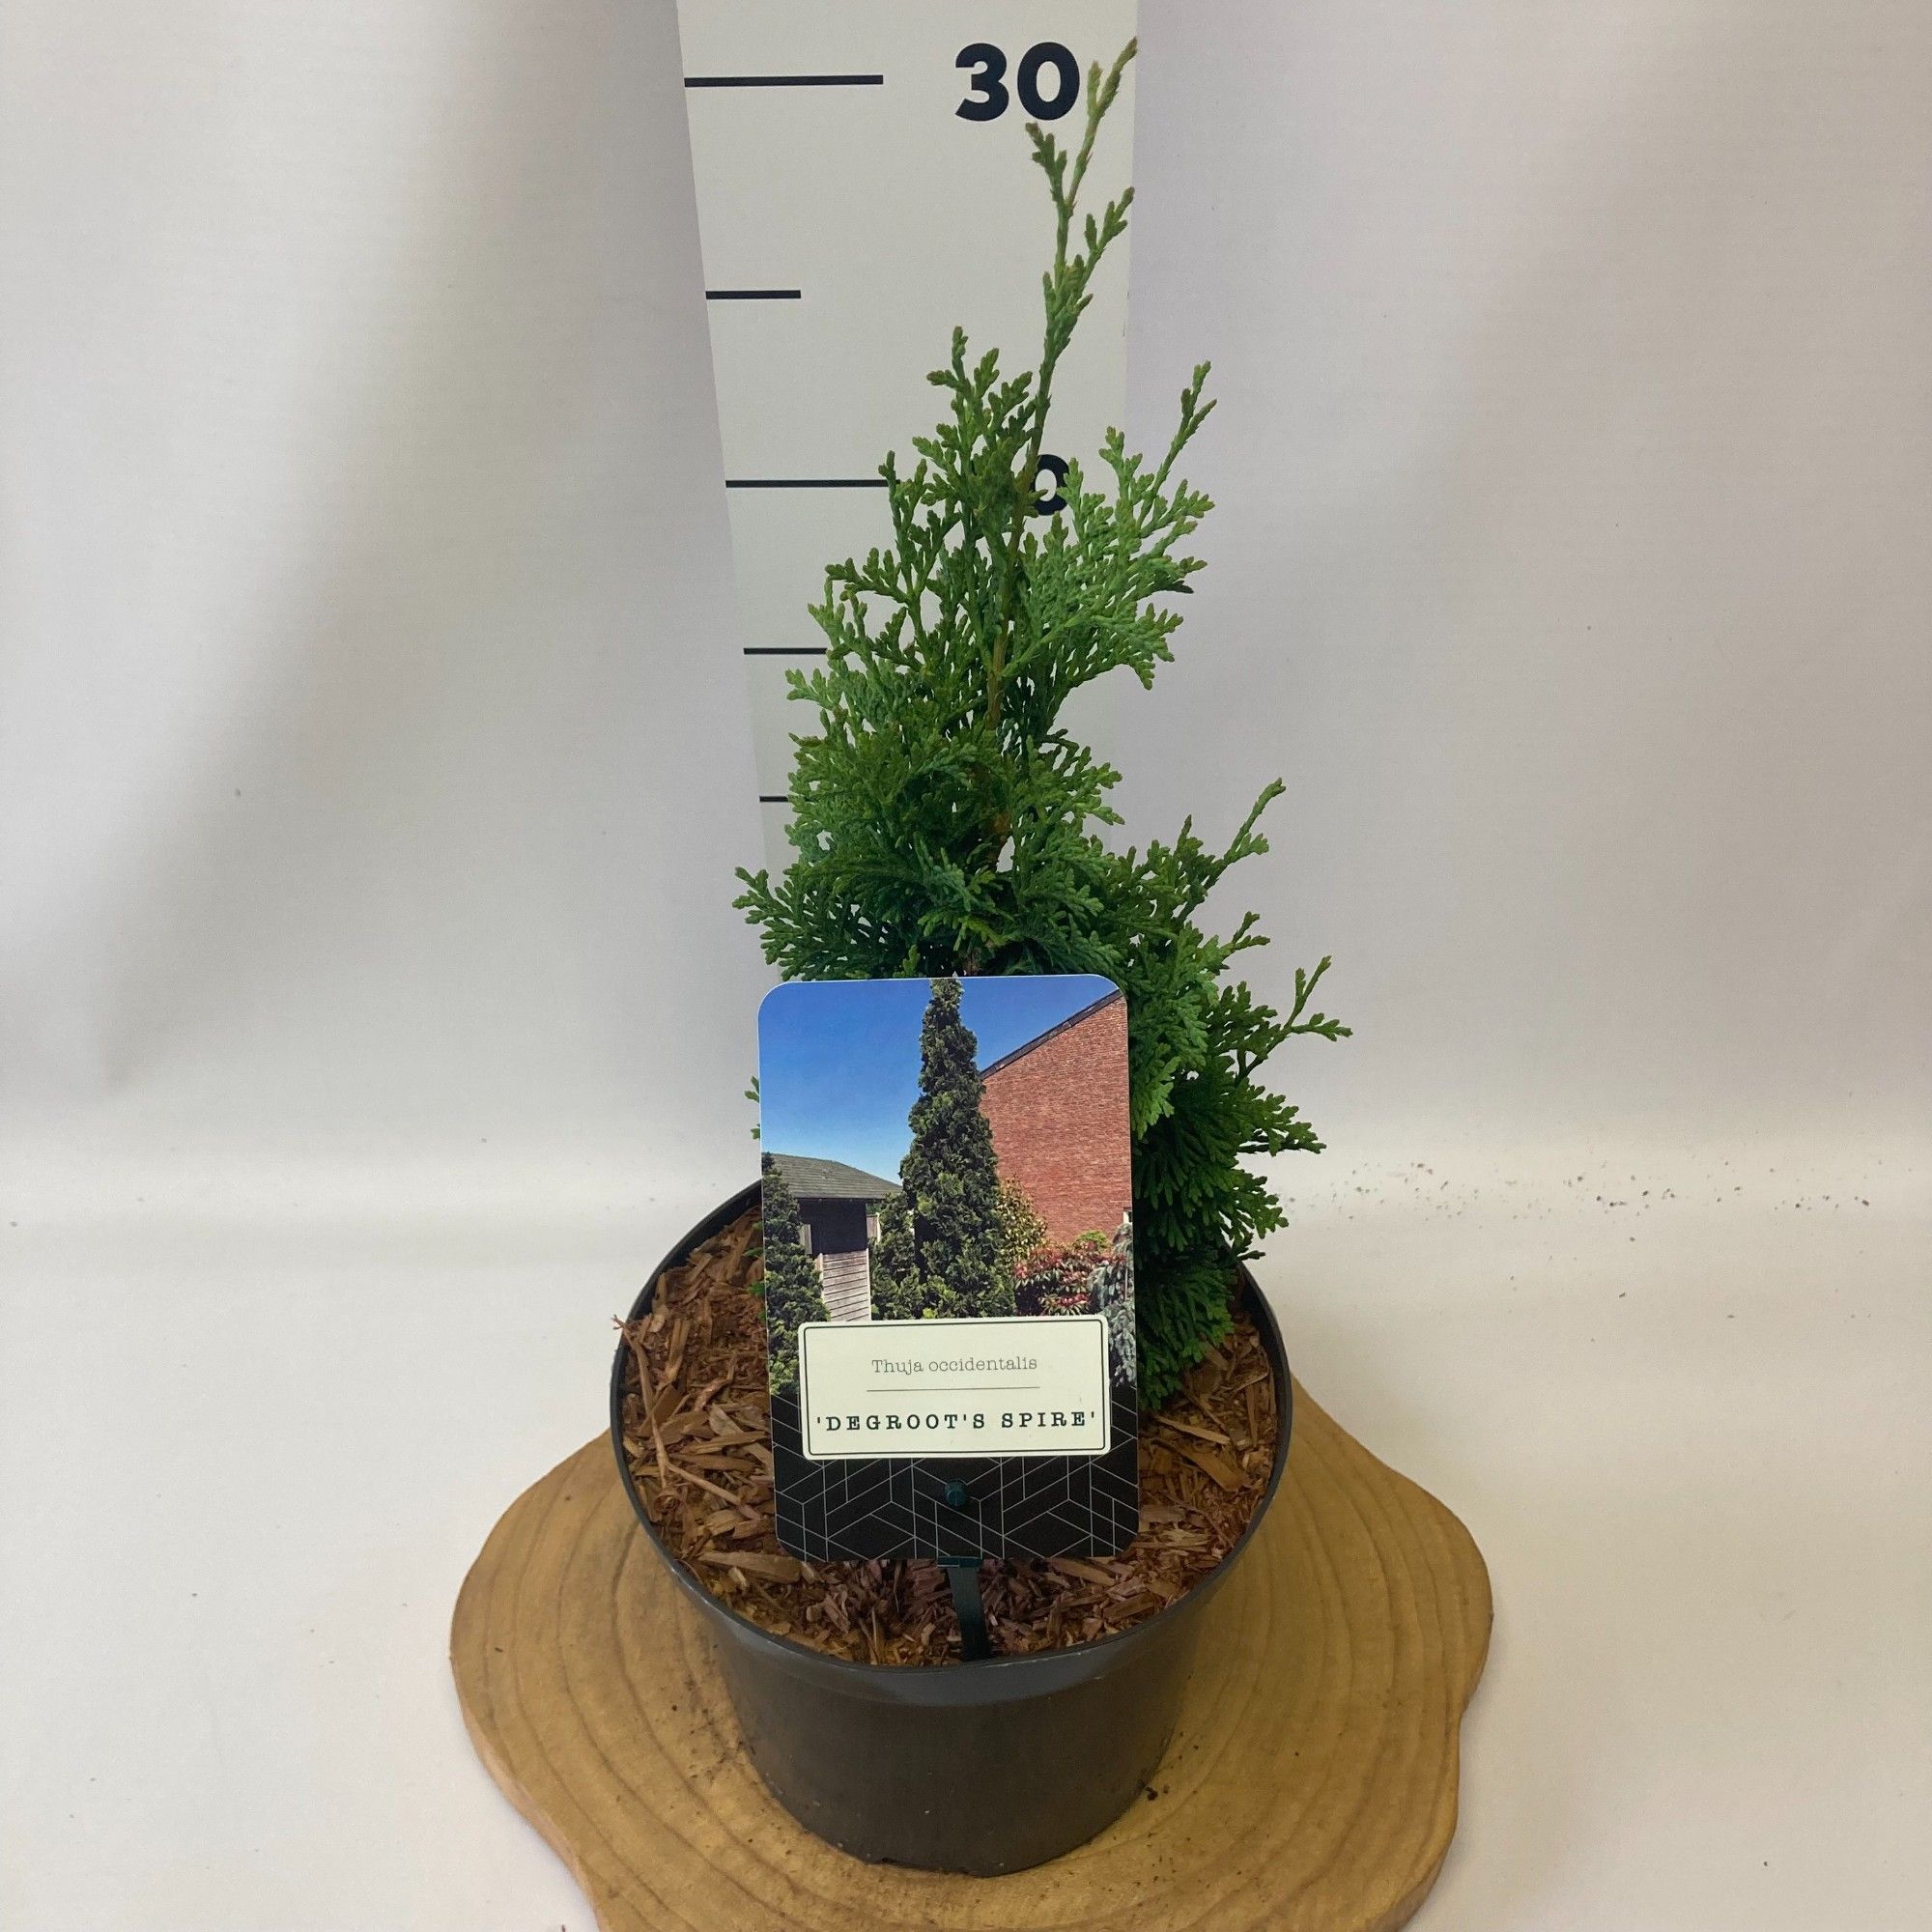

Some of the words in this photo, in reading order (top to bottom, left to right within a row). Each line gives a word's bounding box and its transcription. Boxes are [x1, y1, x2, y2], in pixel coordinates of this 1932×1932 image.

[954, 42, 1080, 122] 30
[871, 1358, 923, 1376] Thuja
[928, 1356, 1037, 1372] occidentalis
[816, 1414, 985, 1432] 'DEGROOT'S
[1001, 1411, 1095, 1428] SPIRE'
